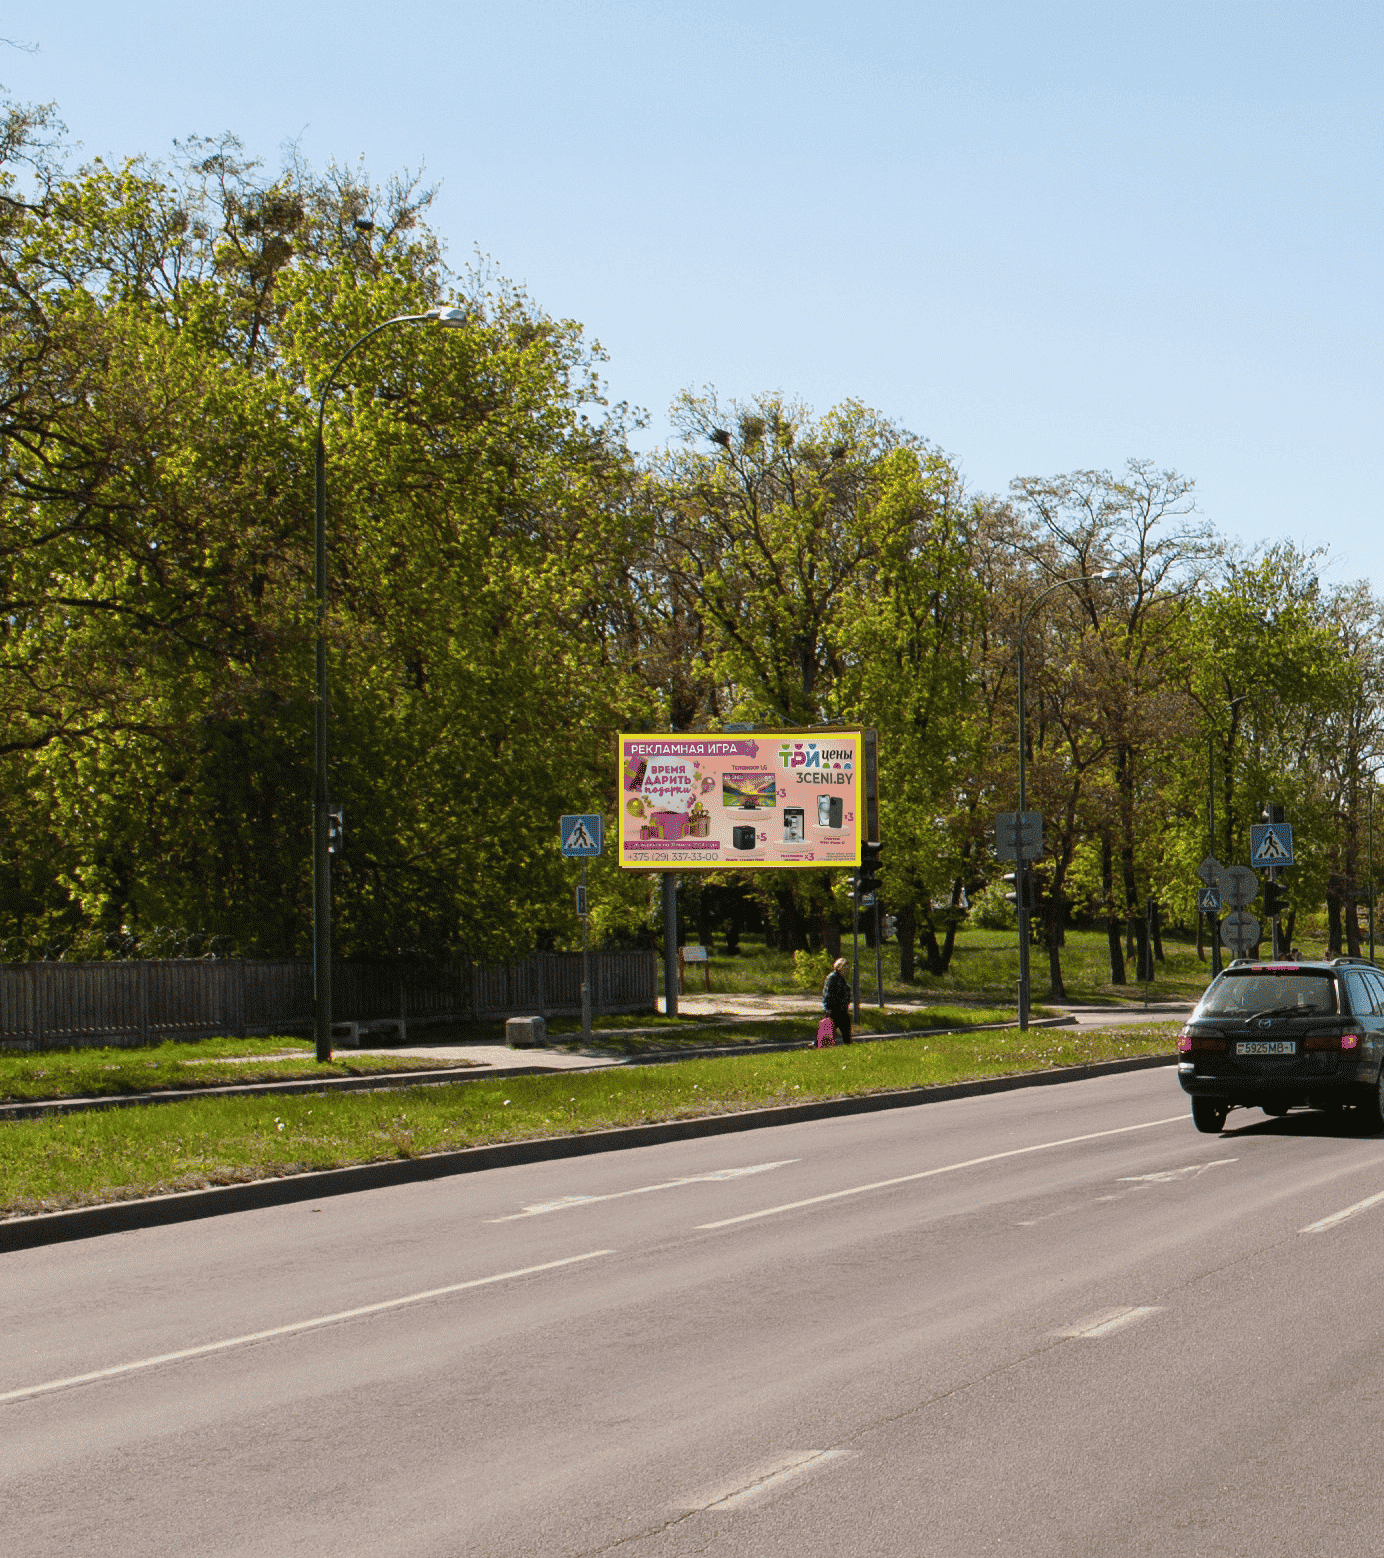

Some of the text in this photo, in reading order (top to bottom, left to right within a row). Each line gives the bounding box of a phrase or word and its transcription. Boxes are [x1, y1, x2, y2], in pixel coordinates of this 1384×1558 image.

[631, 743, 738, 755] РЕКЛАМНАЯ ИГРА
[778, 749, 821, 768] ТРИ
[651, 765, 686, 774] ВРЕМЯ
[644, 775, 692, 786] ДАРИТЬ
[796, 772, 853, 785] 3CENI.BY
[644, 786, 692, 797] подарки
[628, 852, 718, 862] +375 (29) 337-33-00
